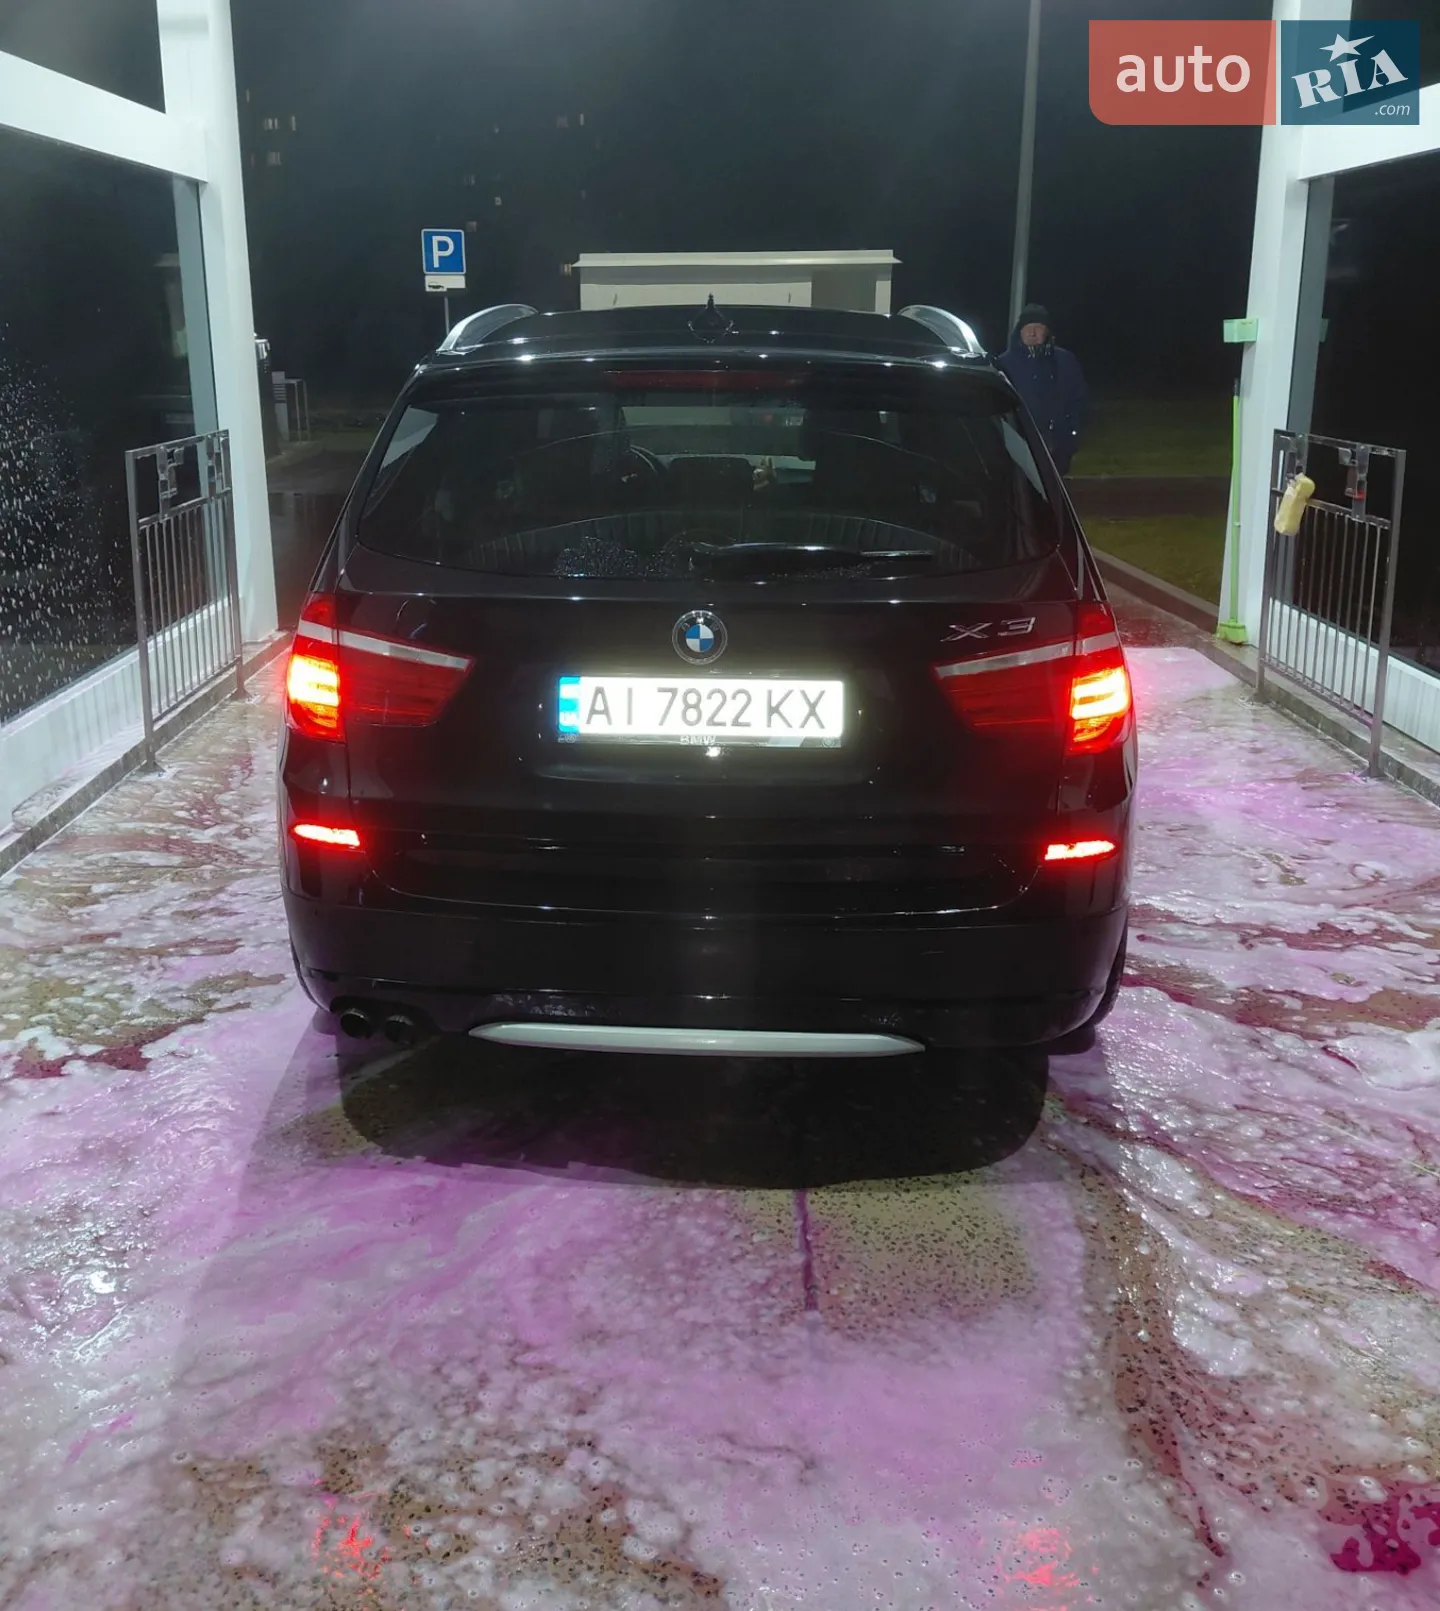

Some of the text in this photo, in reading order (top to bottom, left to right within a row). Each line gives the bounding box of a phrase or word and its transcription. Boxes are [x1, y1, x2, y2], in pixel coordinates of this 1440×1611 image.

[432, 235, 455, 268] P
[585, 686, 826, 730] AI 7822 KX
